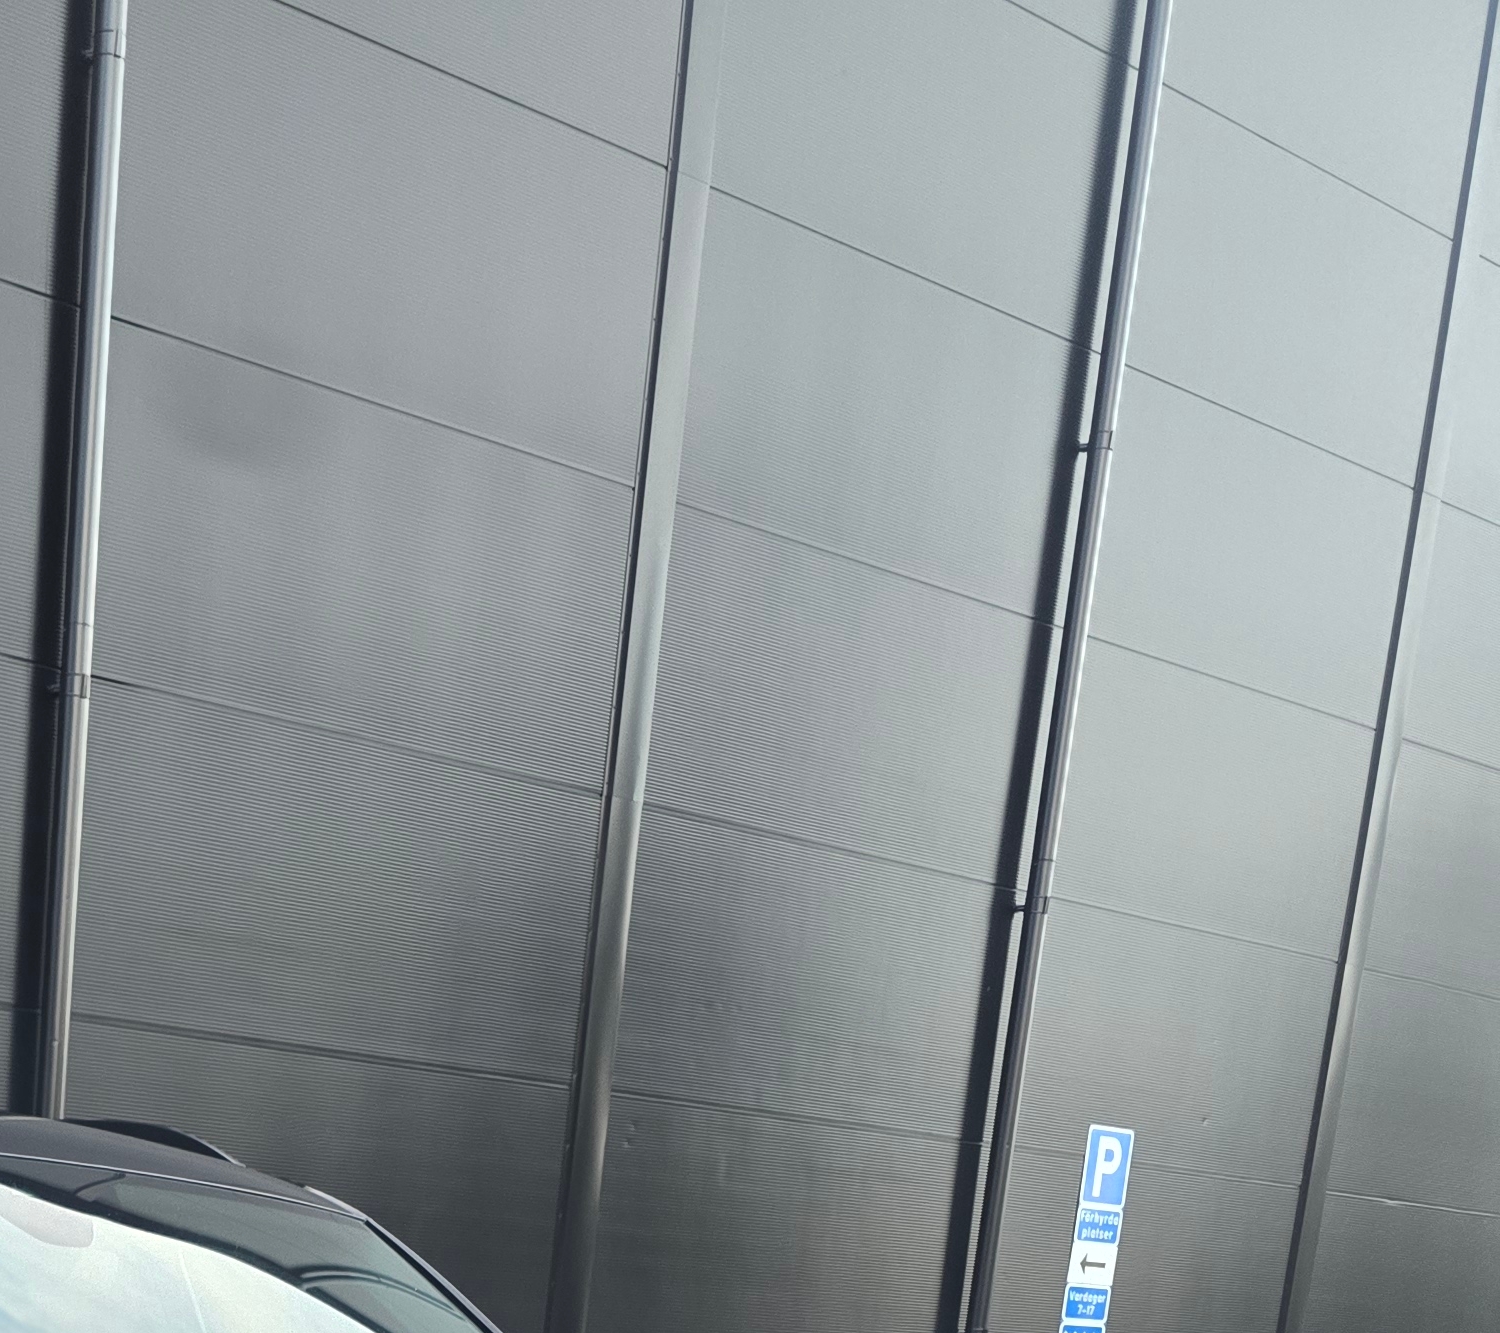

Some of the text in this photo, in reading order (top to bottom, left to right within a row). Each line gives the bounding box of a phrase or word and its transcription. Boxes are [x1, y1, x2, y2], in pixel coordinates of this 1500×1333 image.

[1092, 1135, 1122, 1197] P
[1081, 1210, 1119, 1226] Förhyrda
[1081, 1226, 1114, 1240] platser
[1069, 1290, 1106, 1305] Vardagar
[1077, 1304, 1096, 1316] 7-17
